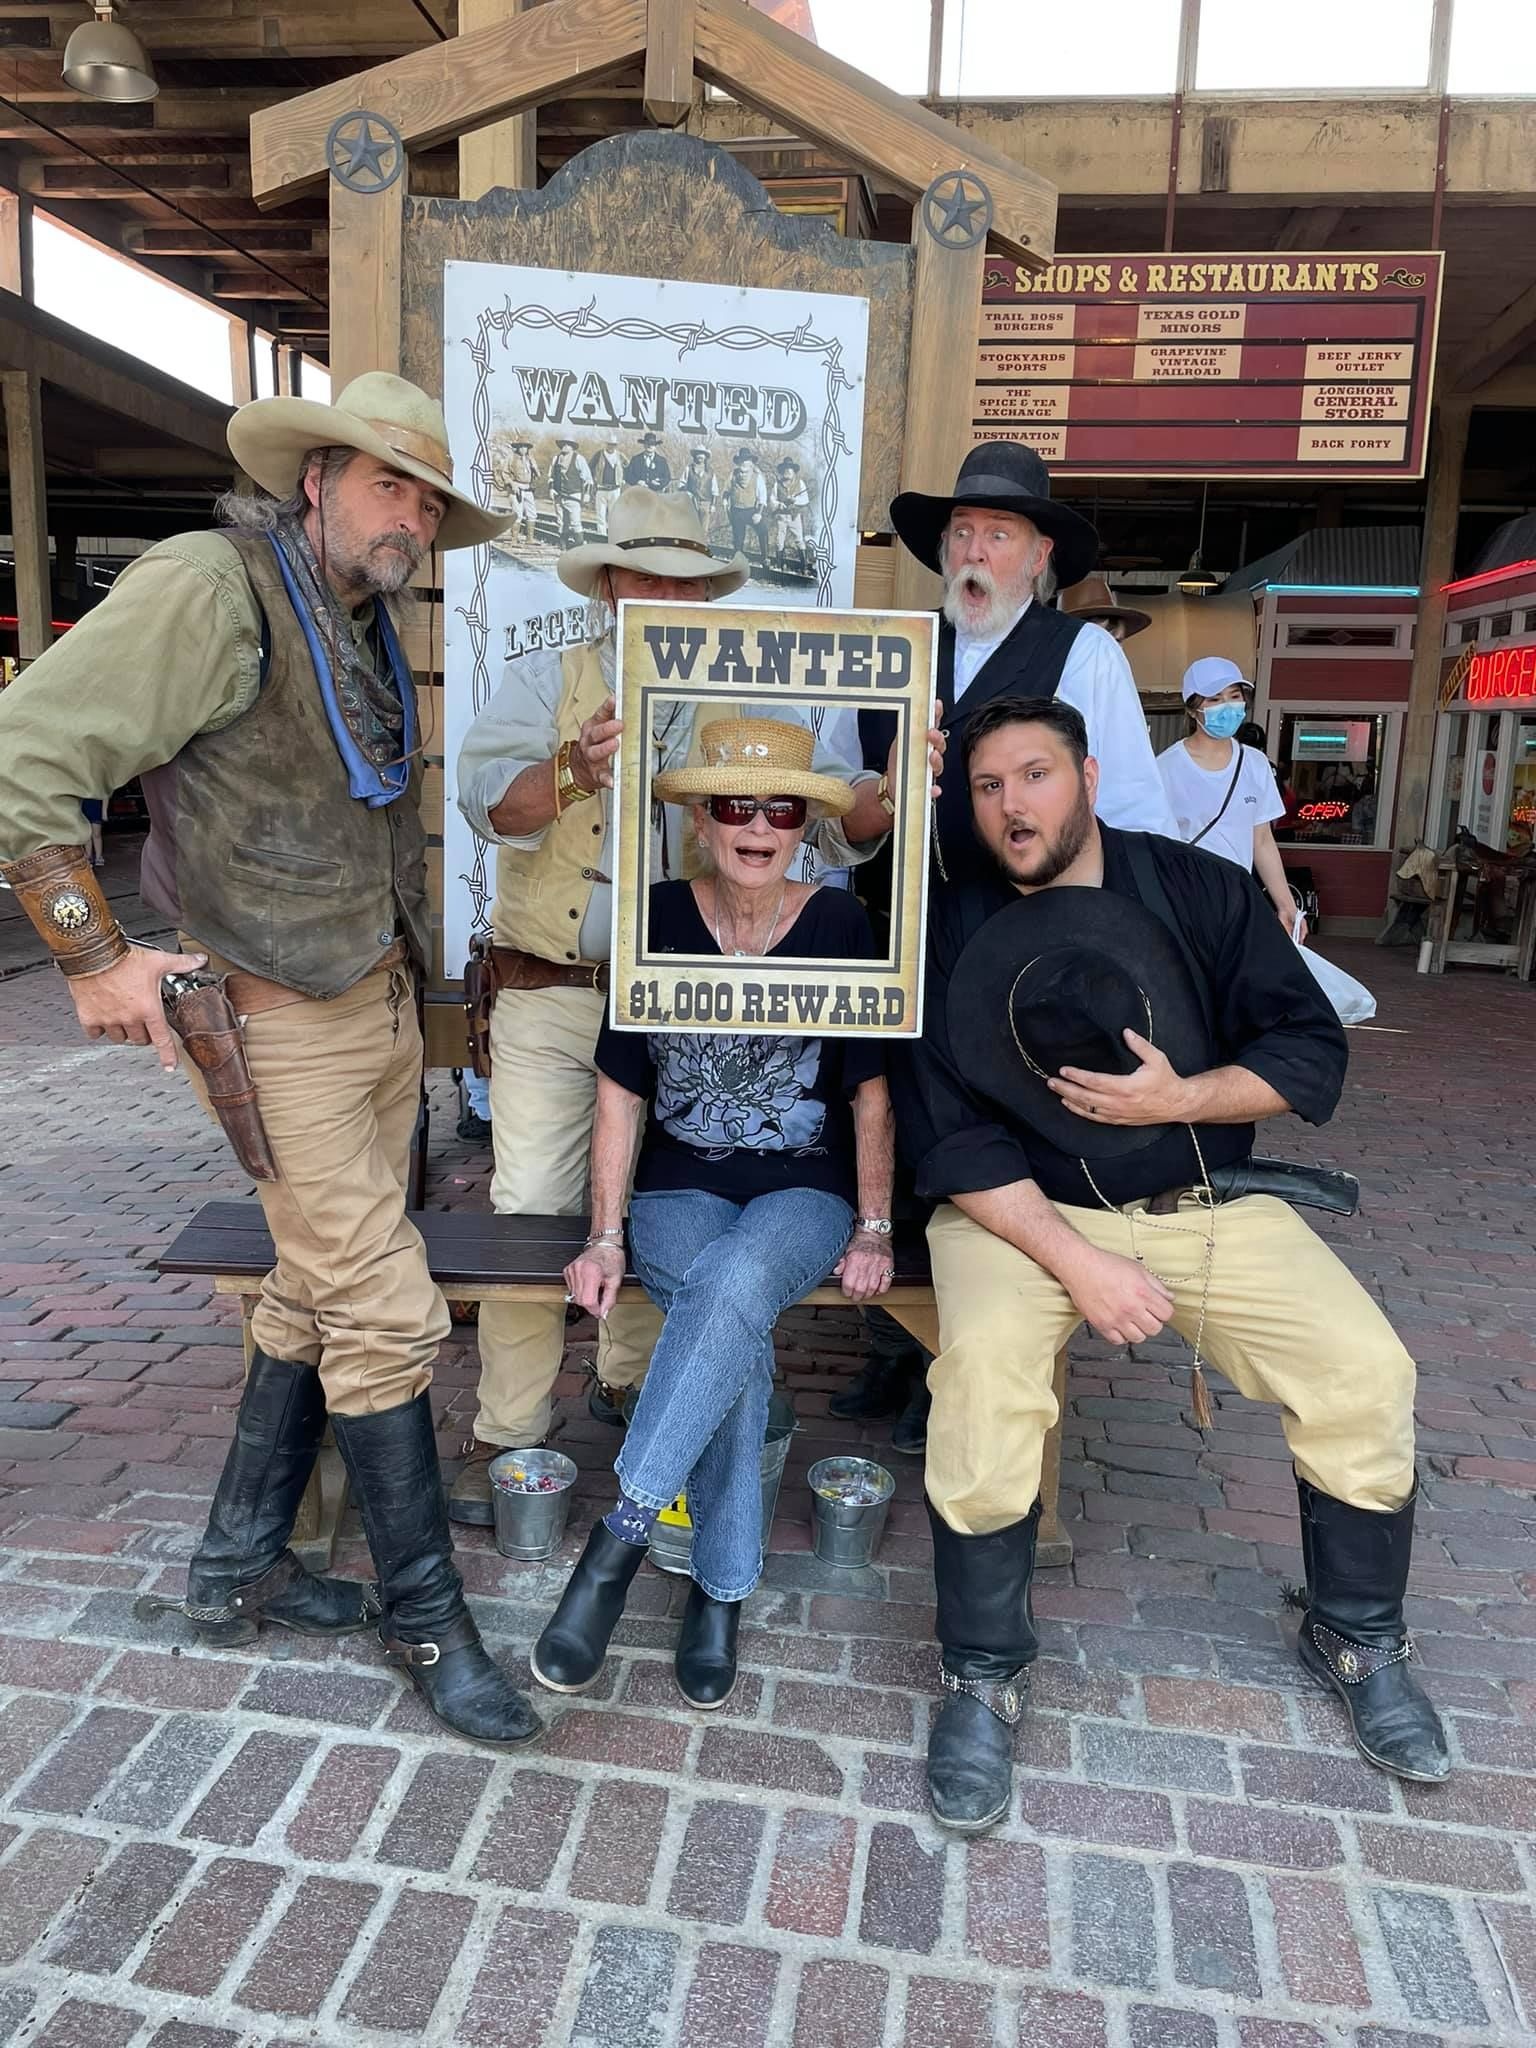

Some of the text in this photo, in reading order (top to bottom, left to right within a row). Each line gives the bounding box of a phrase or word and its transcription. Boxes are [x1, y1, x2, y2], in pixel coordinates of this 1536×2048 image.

[1015, 262, 1380, 293] SHOPS & RESTAURANTS
[984, 312, 1064, 322] TRAIL BOSS
[1143, 310, 1241, 320] TEXAS GOLD
[994, 322, 1054, 331] BURGERS
[1160, 323, 1222, 333] MINORS
[979, 353, 1067, 362] STOCKYARDS
[1150, 348, 1227, 357] GRAPEVINE
[1317, 351, 1403, 361] BEEF JERKY
[1158, 358, 1217, 366] VINTAGE
[1335, 362, 1385, 372] OUTLET
[996, 363, 1048, 372] SPORTS
[1151, 368, 1222, 376] RAILROAD
[1006, 389, 1032, 397] THE
[1318, 386, 1395, 395] LONGHORN
[511, 365, 808, 441] WANTED
[979, 398, 1017, 407] SPICE
[1032, 399, 1057, 407] TEA
[1313, 396, 1399, 407] GENERAL
[983, 408, 1052, 417] EXCHANGE
[1324, 408, 1385, 419] STORE
[973, 431, 1061, 440] DESTINATION
[1311, 439, 1392, 449] BACK FORTY
[643, 624, 912, 689] WANTED
[1467, 647, 1536, 701] BURGE
[1301, 803, 1346, 818] OPEN
[629, 980, 906, 1026] $1,000 REWARD
